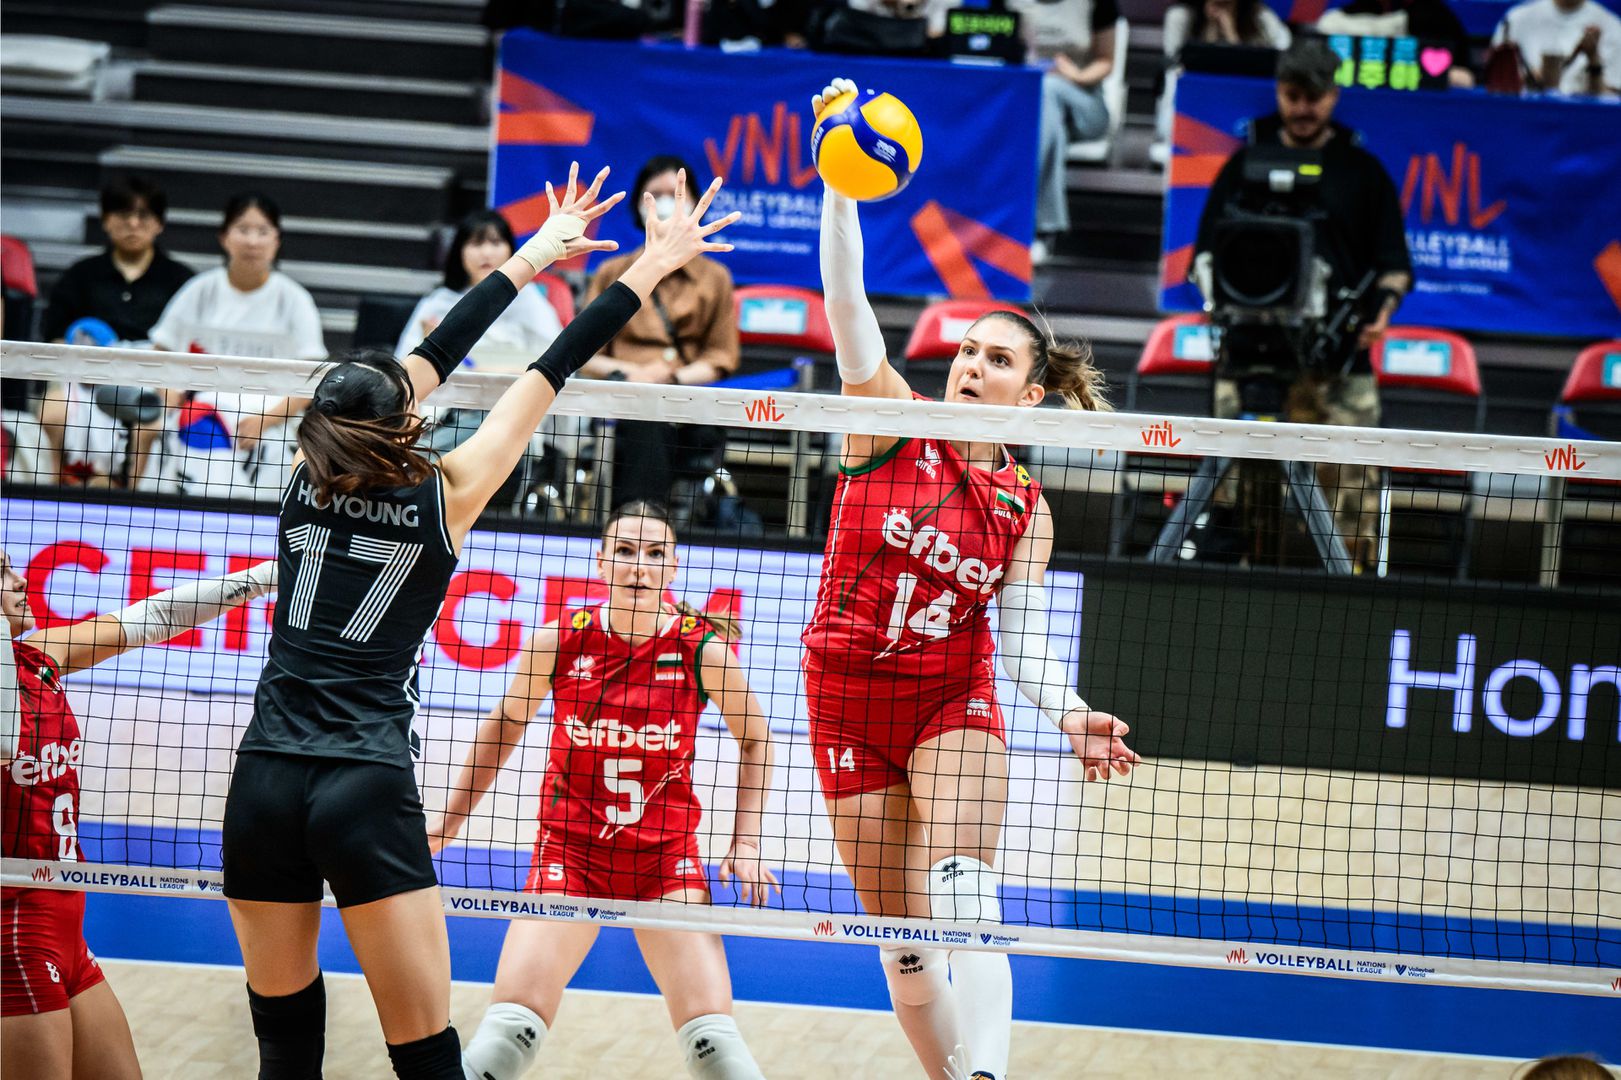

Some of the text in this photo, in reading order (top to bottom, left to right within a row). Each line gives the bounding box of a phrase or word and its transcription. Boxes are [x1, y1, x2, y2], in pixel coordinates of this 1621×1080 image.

[704, 101, 819, 189] VNL
[744, 395, 785, 423] VNL
[1141, 420, 1182, 448] VNL
[1544, 443, 1587, 471] VNL
[881, 511, 1005, 596] efbet
[285, 523, 425, 643] 17
[886, 571, 958, 643] 14
[563, 716, 682, 752] efbet
[827, 746, 857, 775] 14
[603, 757, 646, 826] 5
[31, 865, 158, 889] VNL VOLLEYBALL
[159, 876, 190, 885] NATIONS
[547, 862, 565, 882] 5
[941, 869, 965, 884] errea
[159, 882, 186, 891] LEAGUE
[450, 896, 548, 917] VOLLEYBALL
[549, 910, 576, 919] LEAGUE
[550, 903, 580, 913] NATIONS
[813, 919, 940, 943] VNL VOLLEYBALL
[942, 929, 972, 939] NATIONS
[942, 936, 968, 945] LEAGUE
[899, 964, 925, 976] errea
[1226, 947, 1354, 973] VNL VOLLEYBALL
[1356, 960, 1387, 969] NATIONS
[1356, 967, 1383, 975] LEAGUE
[45, 961, 61, 984] 8
